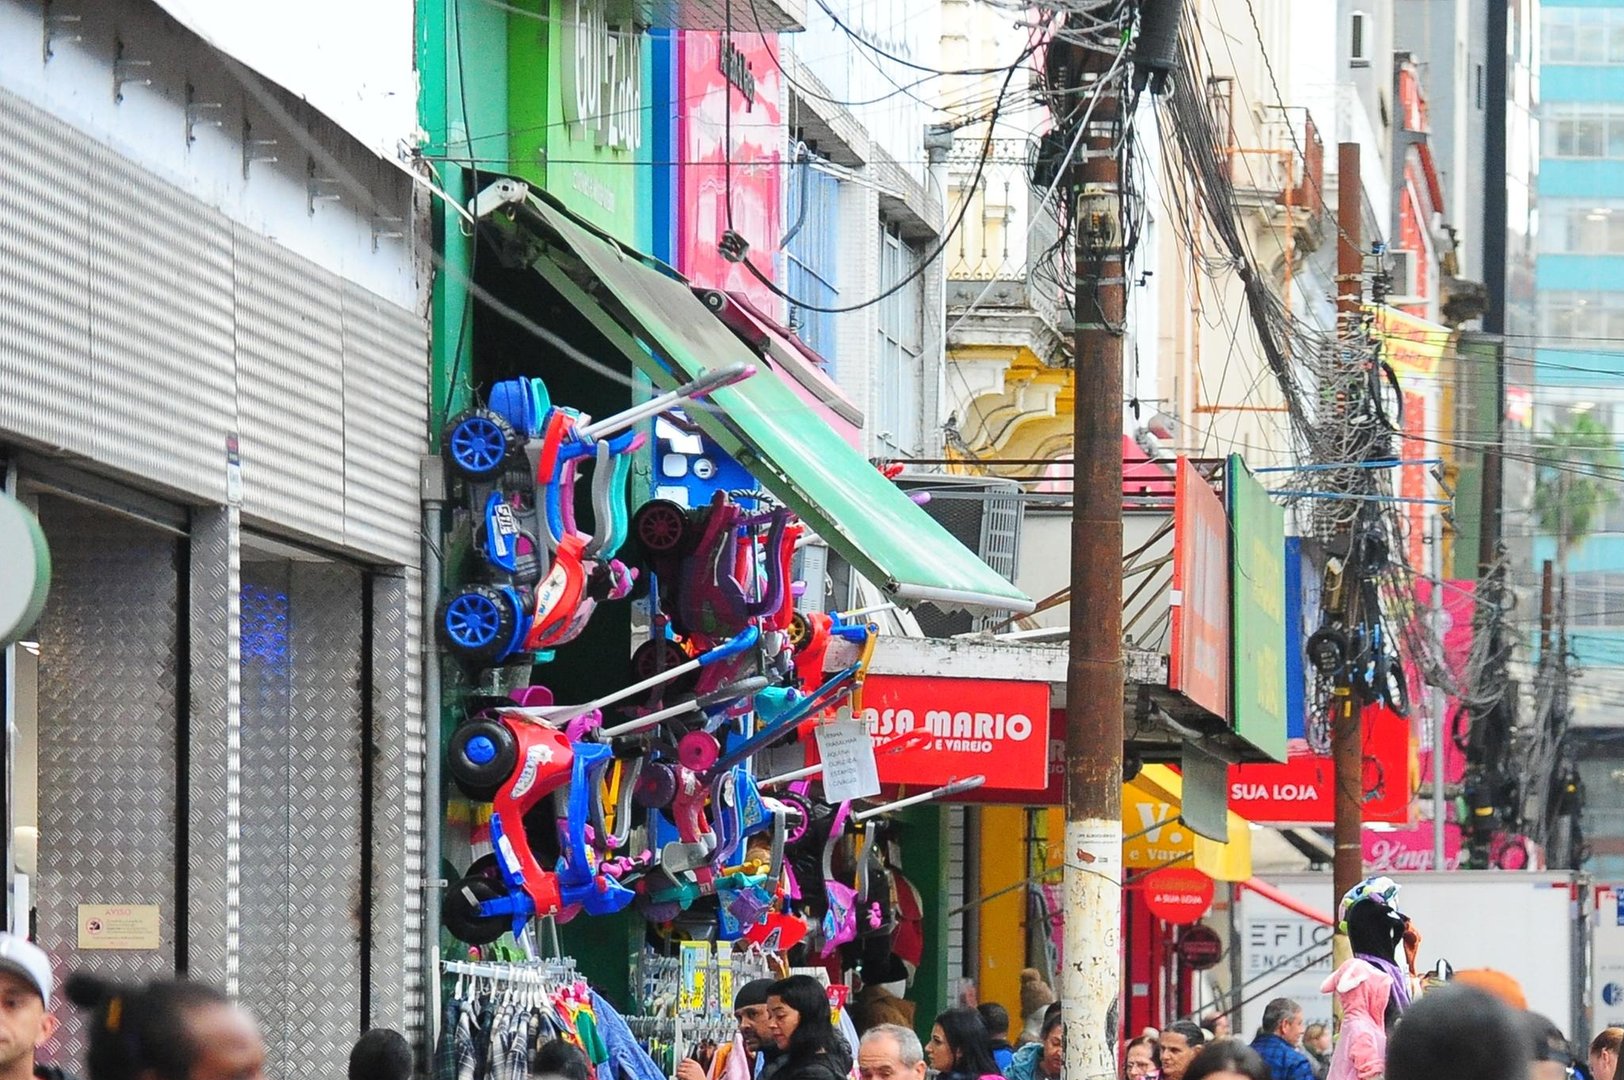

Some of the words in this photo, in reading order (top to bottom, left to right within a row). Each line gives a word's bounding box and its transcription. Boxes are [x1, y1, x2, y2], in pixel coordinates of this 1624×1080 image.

[862, 708, 915, 735] ASA
[924, 710, 1033, 742] MARIO
[946, 739, 993, 753] VAREJO
[1231, 784, 1270, 800] SUA
[1273, 784, 1319, 800] LOJA
